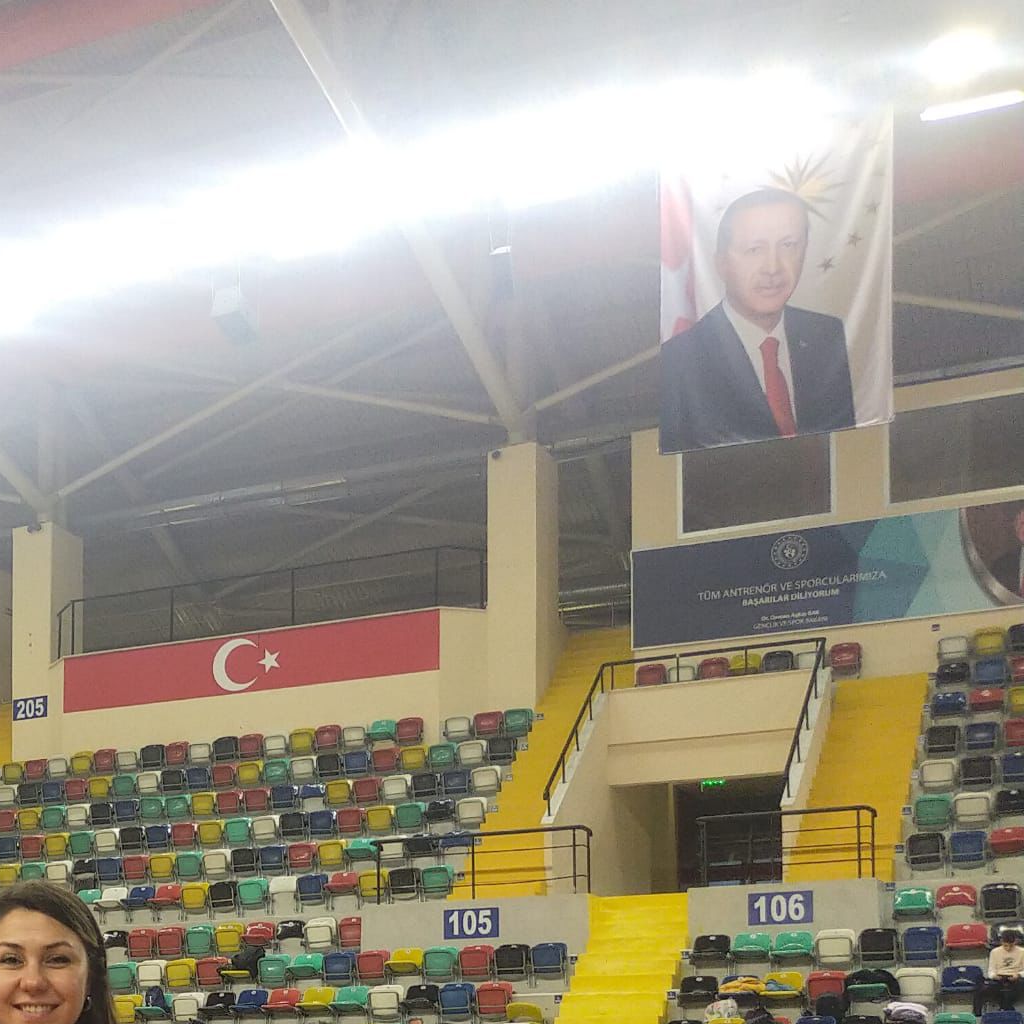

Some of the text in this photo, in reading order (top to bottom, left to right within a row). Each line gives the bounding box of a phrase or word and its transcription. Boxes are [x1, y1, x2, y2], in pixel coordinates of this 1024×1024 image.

[698, 591, 721, 601] TÜM
[722, 583, 777, 599] ANTRENÖR
[780, 582, 793, 592] VE
[742, 593, 789, 608] BAŞARILAR
[16, 698, 44, 719] 205
[754, 894, 805, 922] 106
[449, 910, 492, 935] 105
